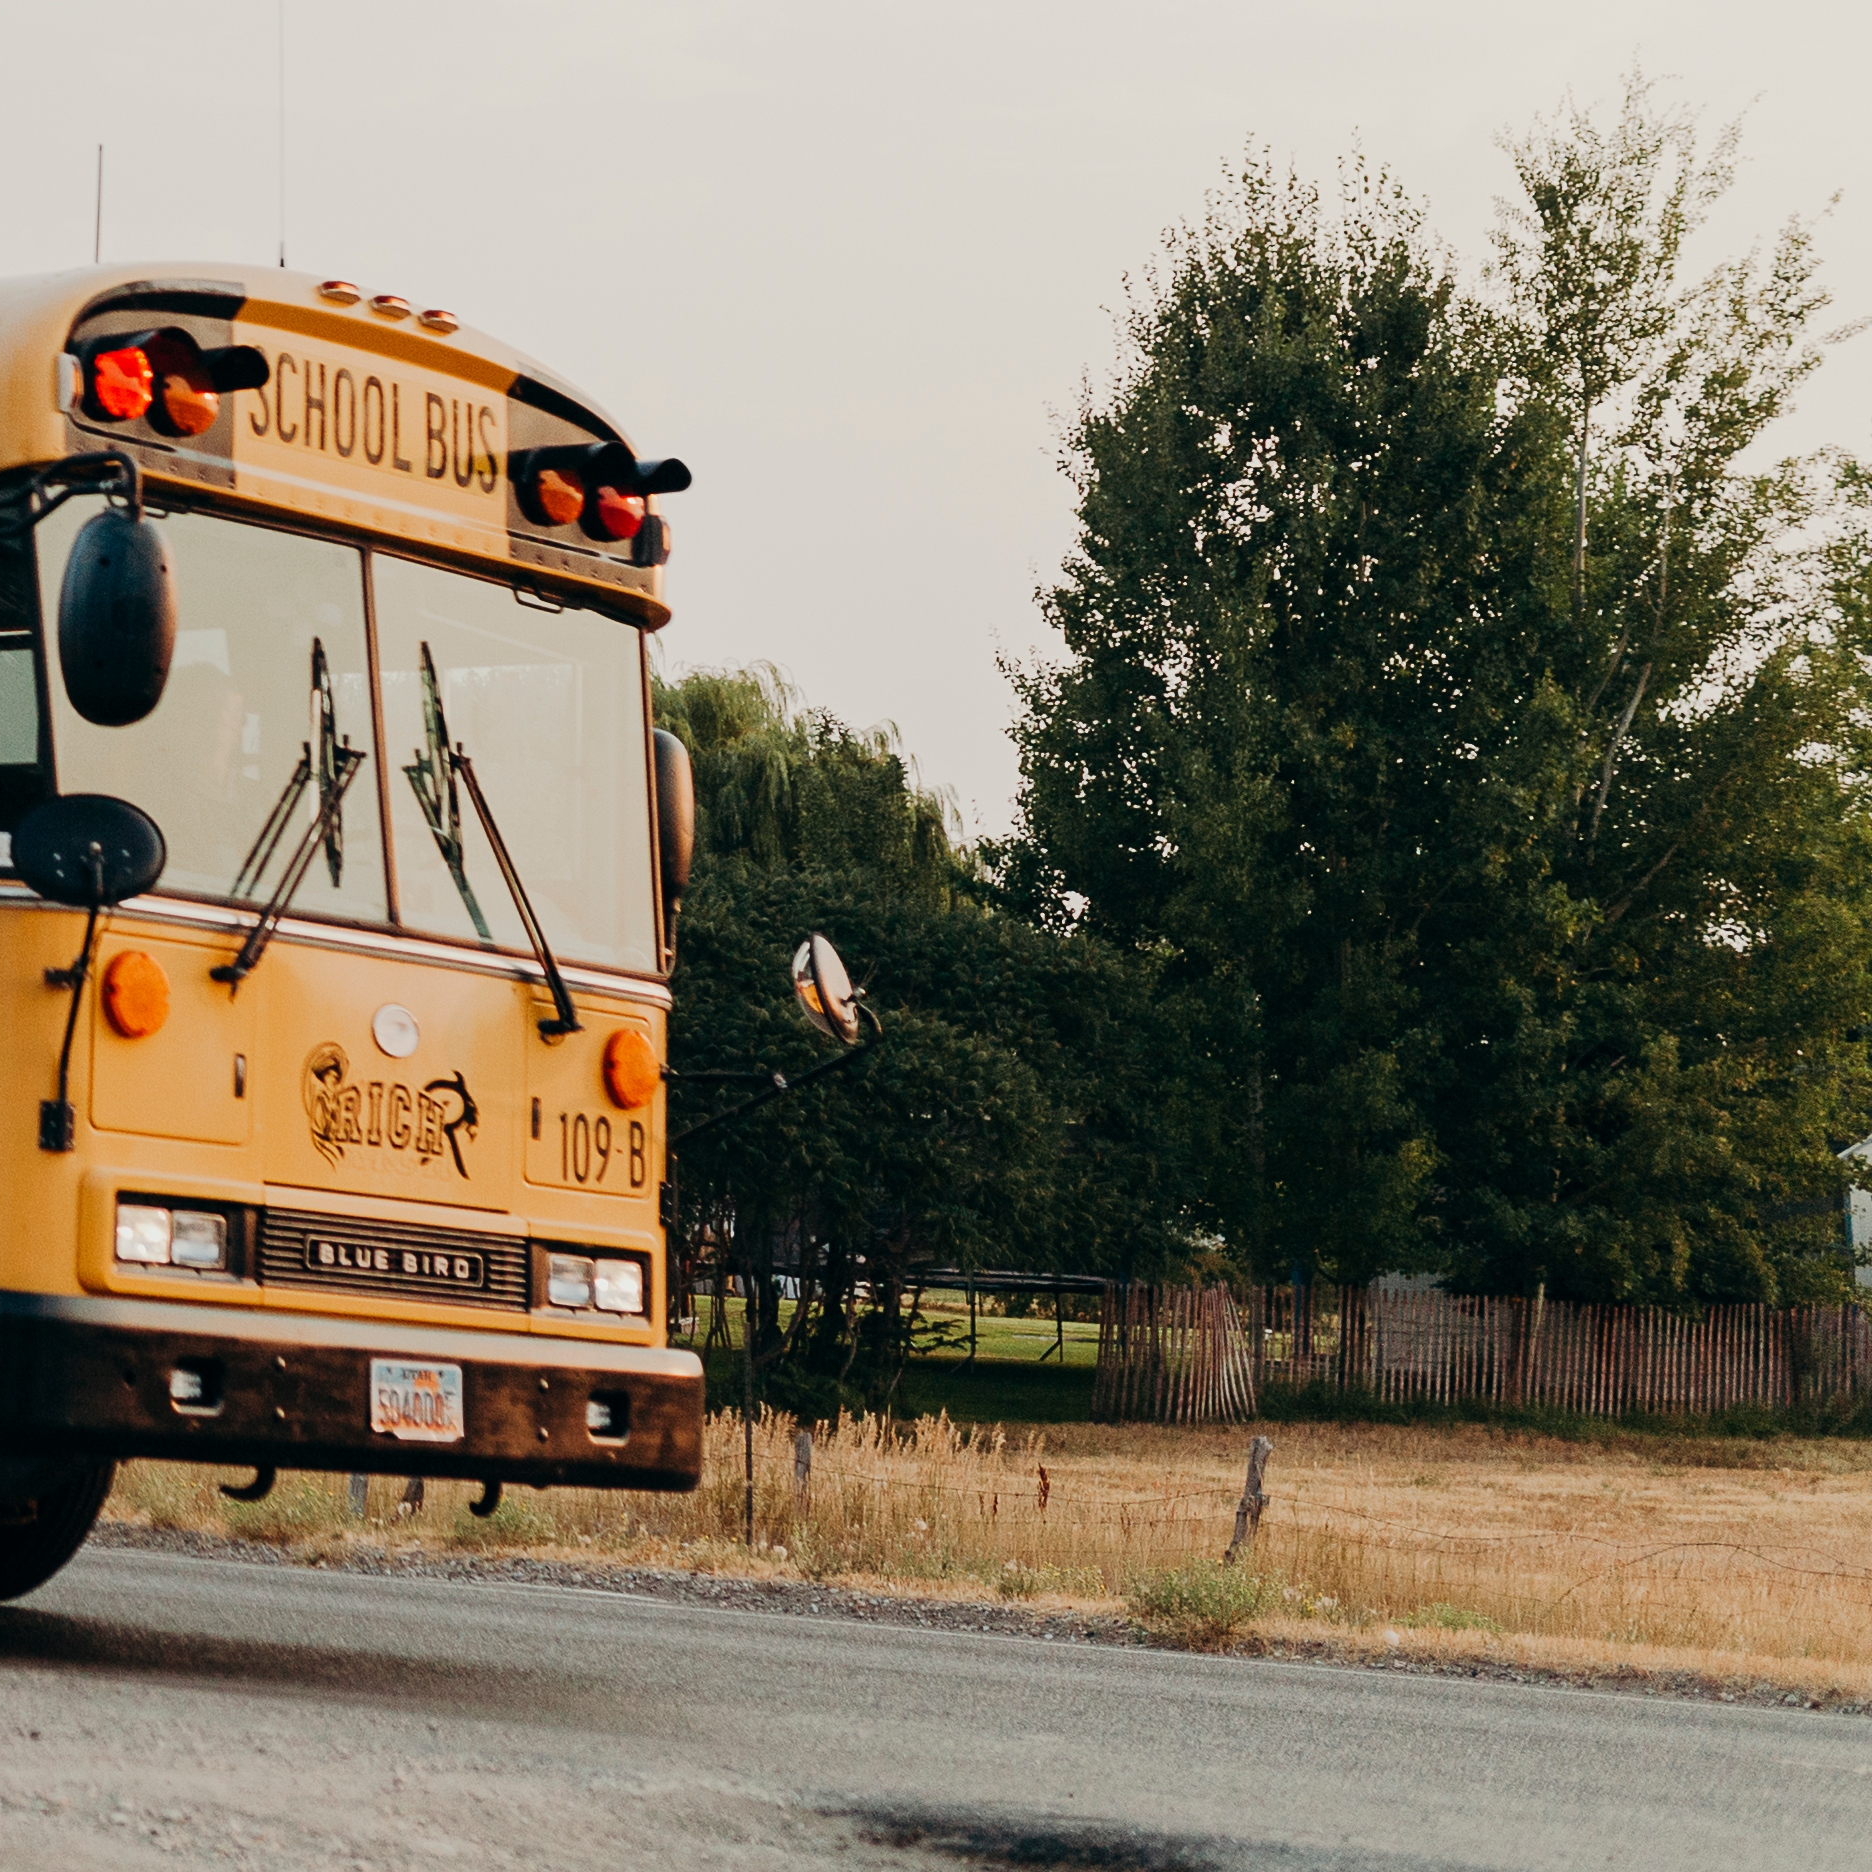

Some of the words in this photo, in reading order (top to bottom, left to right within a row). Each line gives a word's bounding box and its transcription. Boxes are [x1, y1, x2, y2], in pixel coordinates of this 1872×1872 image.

[249, 345, 412, 473] SCHOOL
[425, 390, 498, 494] BUS
[334, 1080, 446, 1157] RICH
[559, 1112, 646, 1189] 109-B
[318, 1242, 390, 1271] BLUE
[402, 1251, 470, 1279] BIRD
